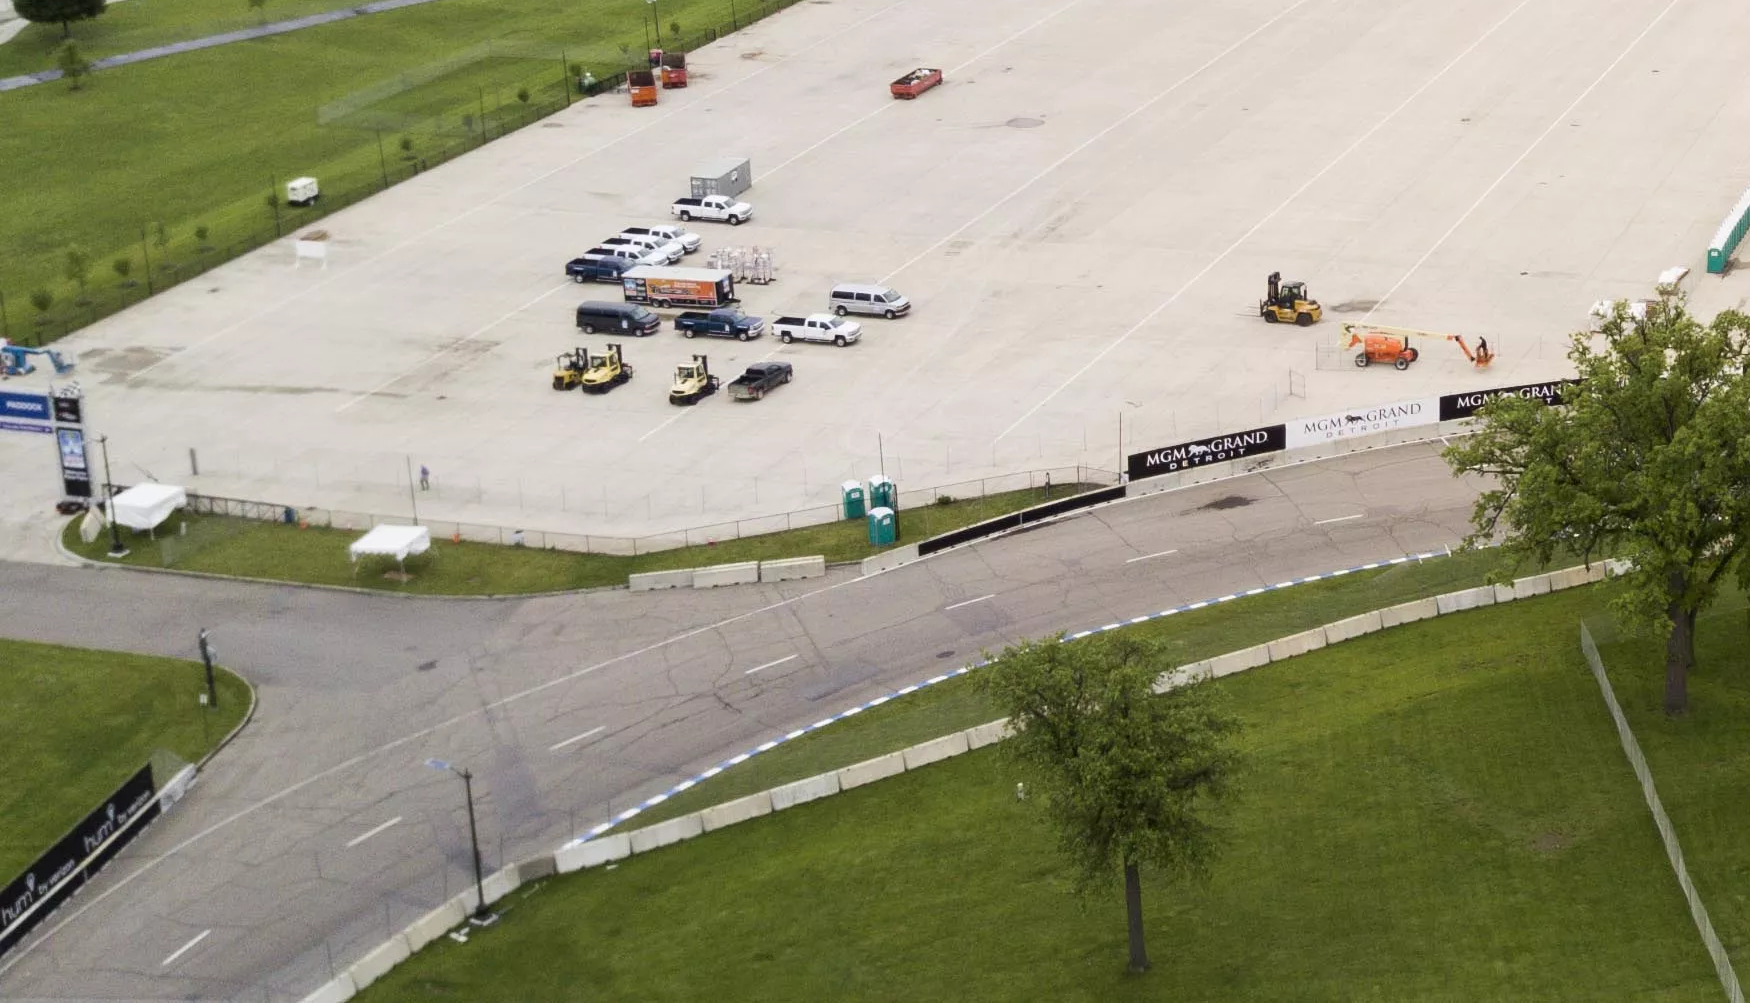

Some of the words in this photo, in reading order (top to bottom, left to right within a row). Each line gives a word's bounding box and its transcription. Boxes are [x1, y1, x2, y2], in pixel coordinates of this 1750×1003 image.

[1519, 383, 1570, 400] GRAN
[1304, 417, 1342, 435] MGM
[1366, 402, 1422, 422] GRAND
[1326, 419, 1400, 439] DETROIT
[1146, 447, 1187, 468] MGM
[1210, 431, 1268, 452] GRAND
[1169, 448, 1246, 470] DETROIT
[83, 818, 115, 853] hum
[2, 891, 33, 927] hum
[49, 859, 75, 885] verizon
